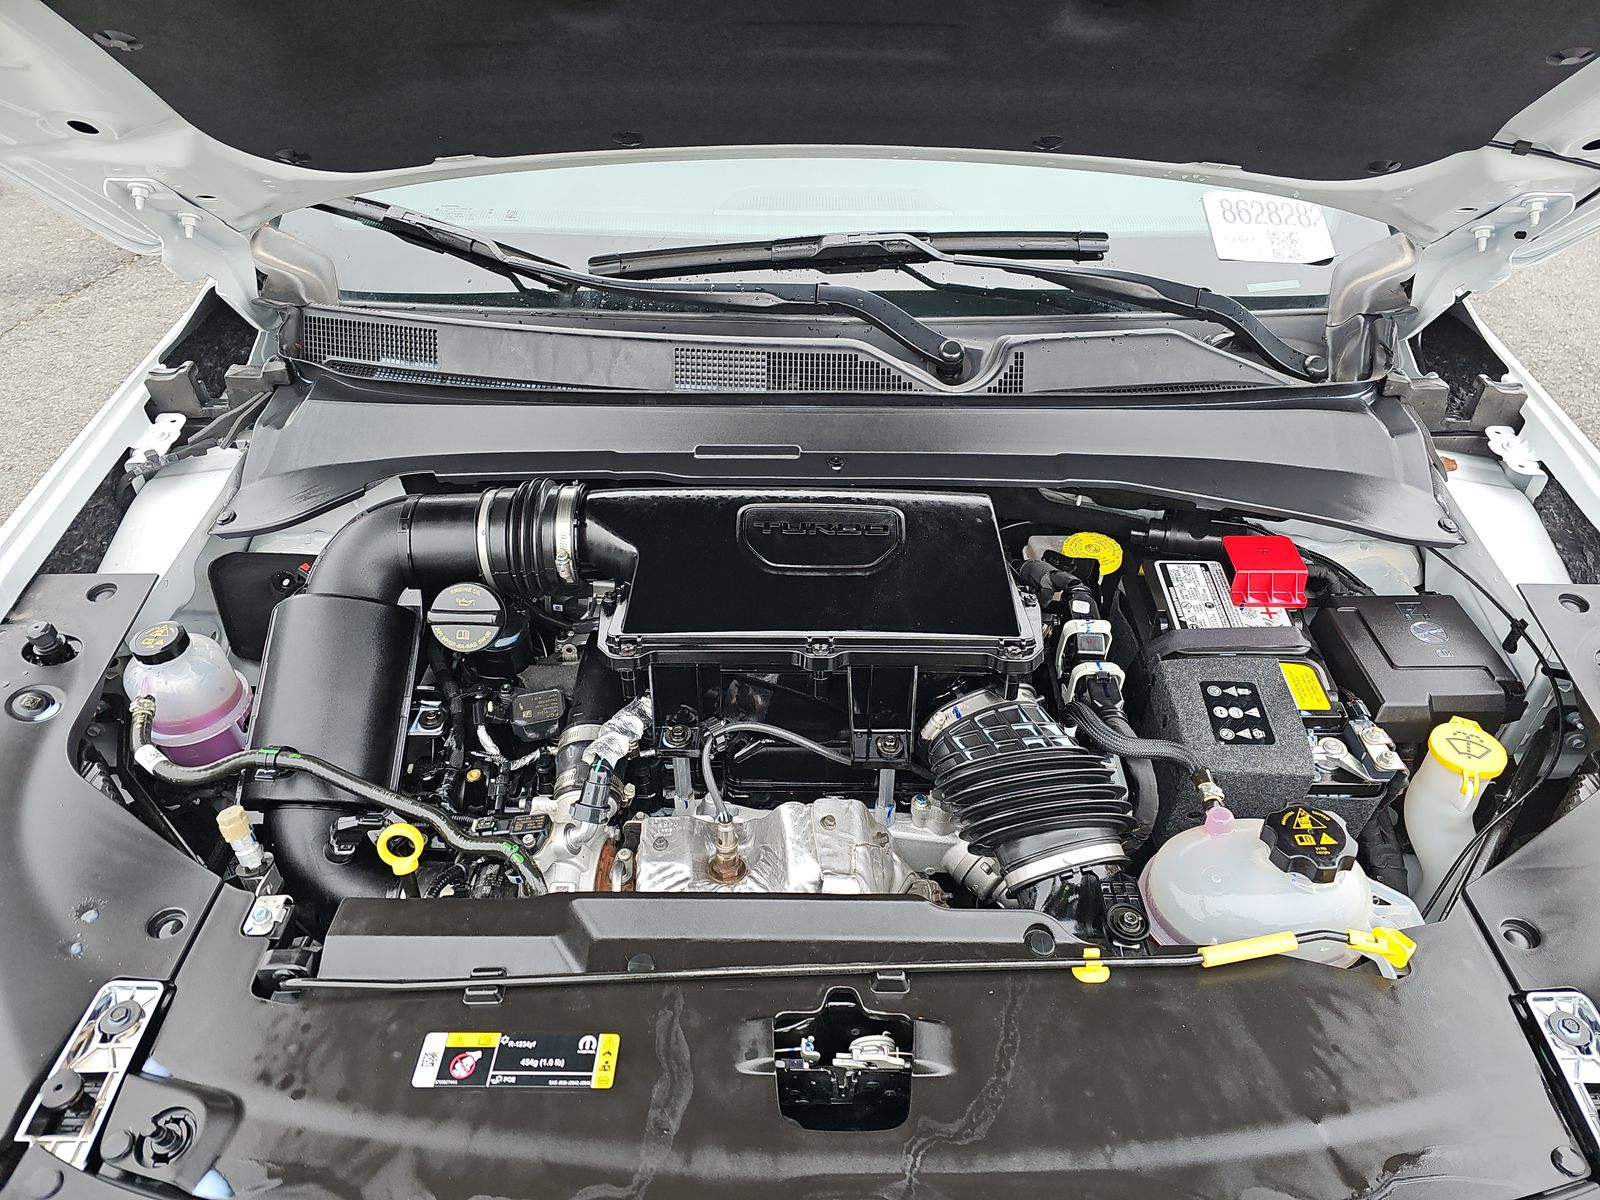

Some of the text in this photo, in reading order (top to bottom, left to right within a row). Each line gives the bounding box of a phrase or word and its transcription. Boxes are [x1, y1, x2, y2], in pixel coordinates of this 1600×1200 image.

[753, 520, 892, 536] TURBO
[450, 586, 481, 597] ENGINE OIL
